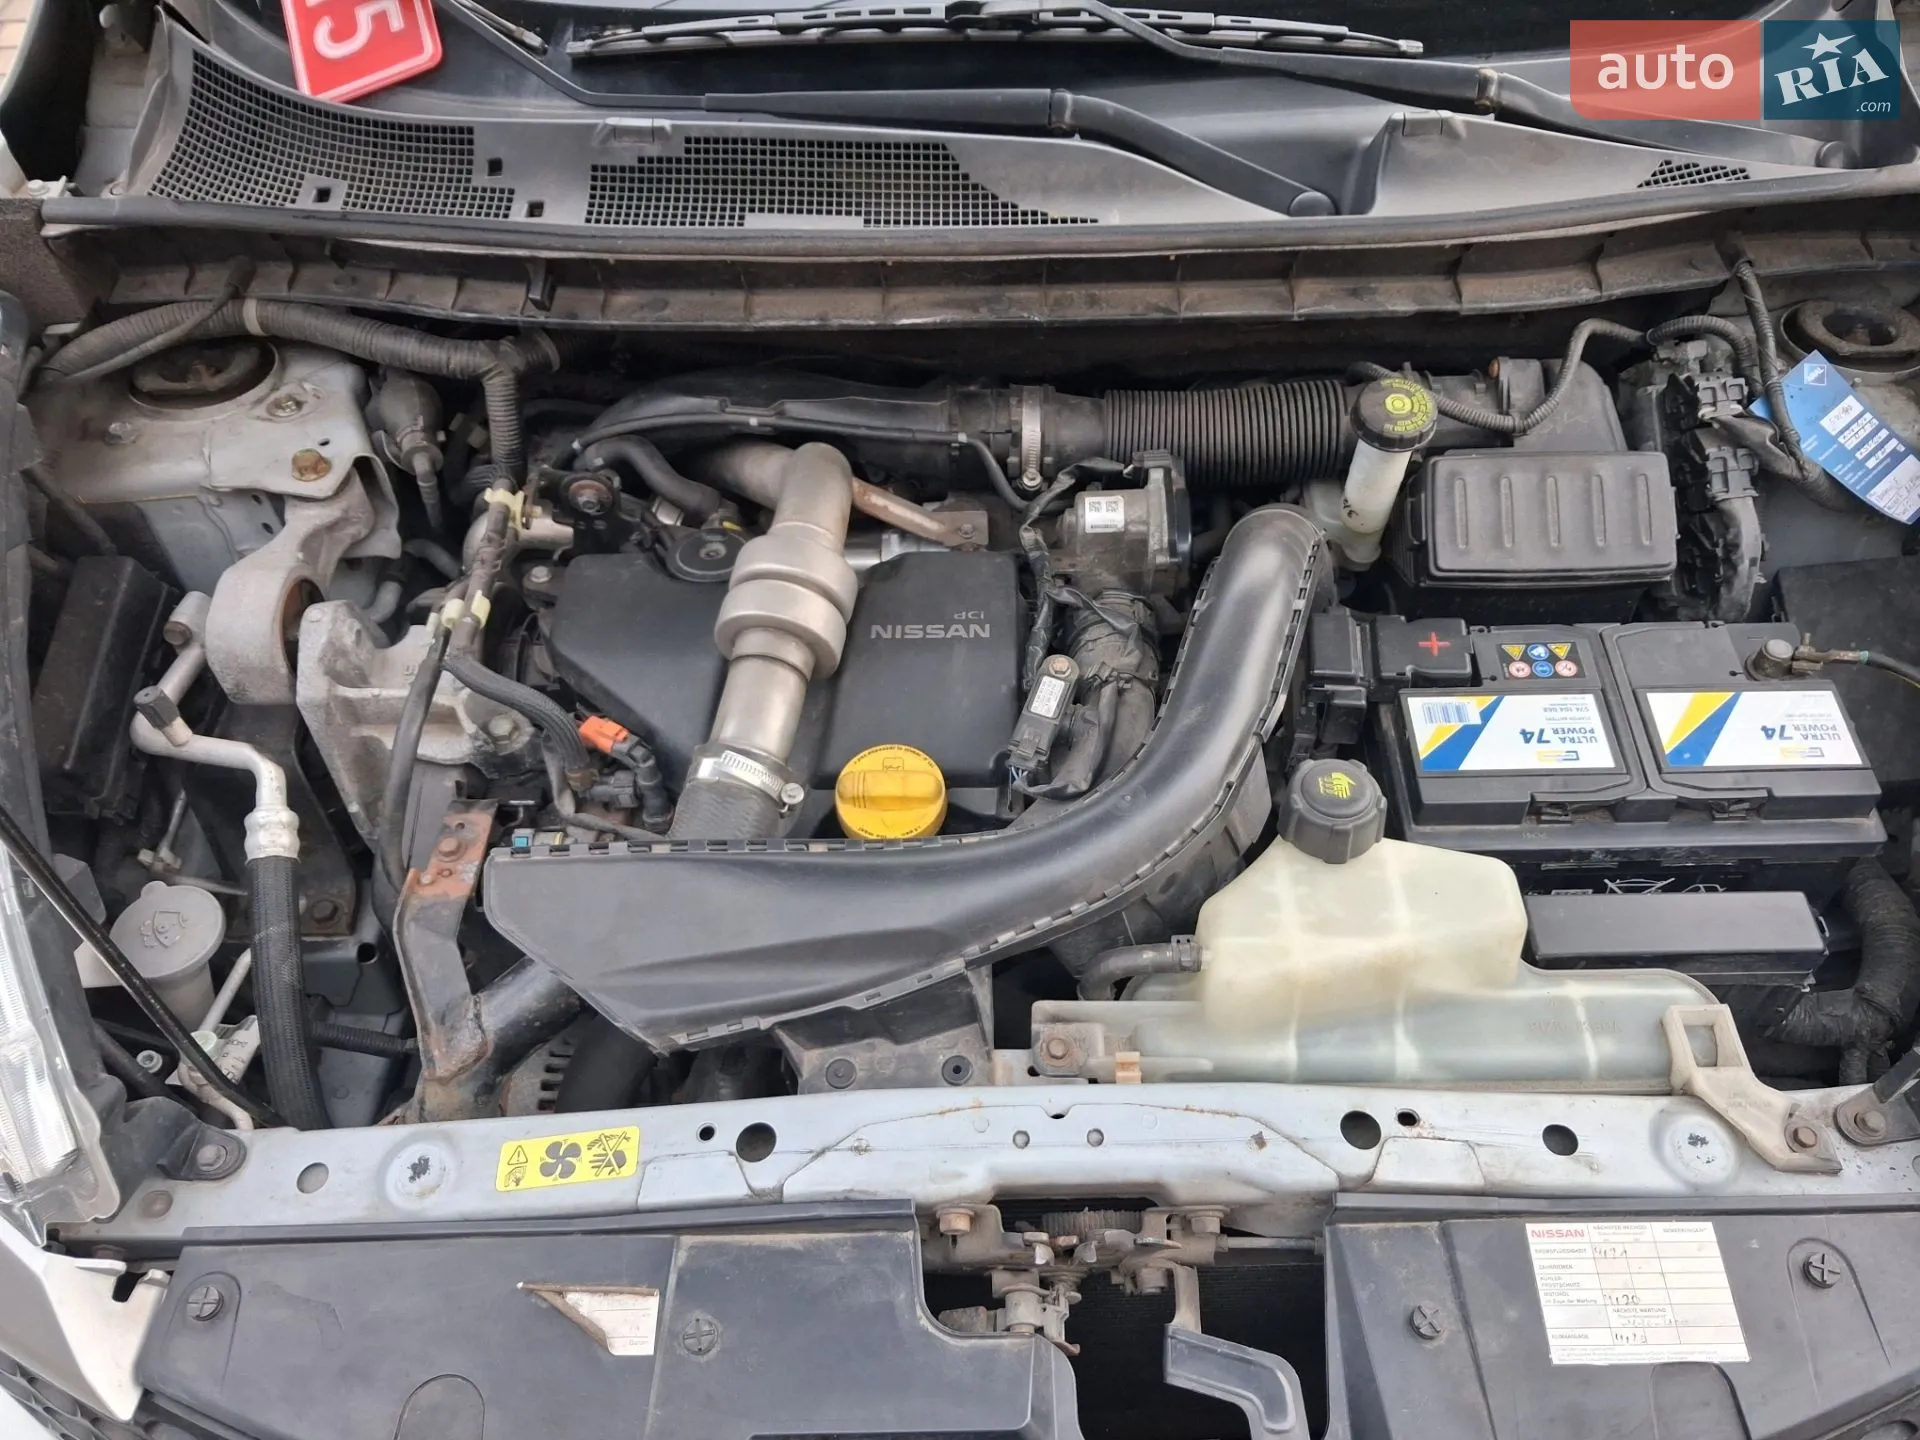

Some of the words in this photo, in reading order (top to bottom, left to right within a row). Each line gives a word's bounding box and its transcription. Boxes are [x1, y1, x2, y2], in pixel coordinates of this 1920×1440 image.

[306, 0, 405, 59] 5
[870, 623, 990, 639] NISSAN
[1551, 727, 1595, 735] POWER
[1760, 724, 1794, 741] 74
[1791, 724, 1838, 732] POWER
[1519, 728, 1551, 744] 74
[1558, 736, 1598, 744] ULTRA
[1799, 732, 1842, 741] ULTRA
[1530, 1228, 1586, 1239] NISSAN
